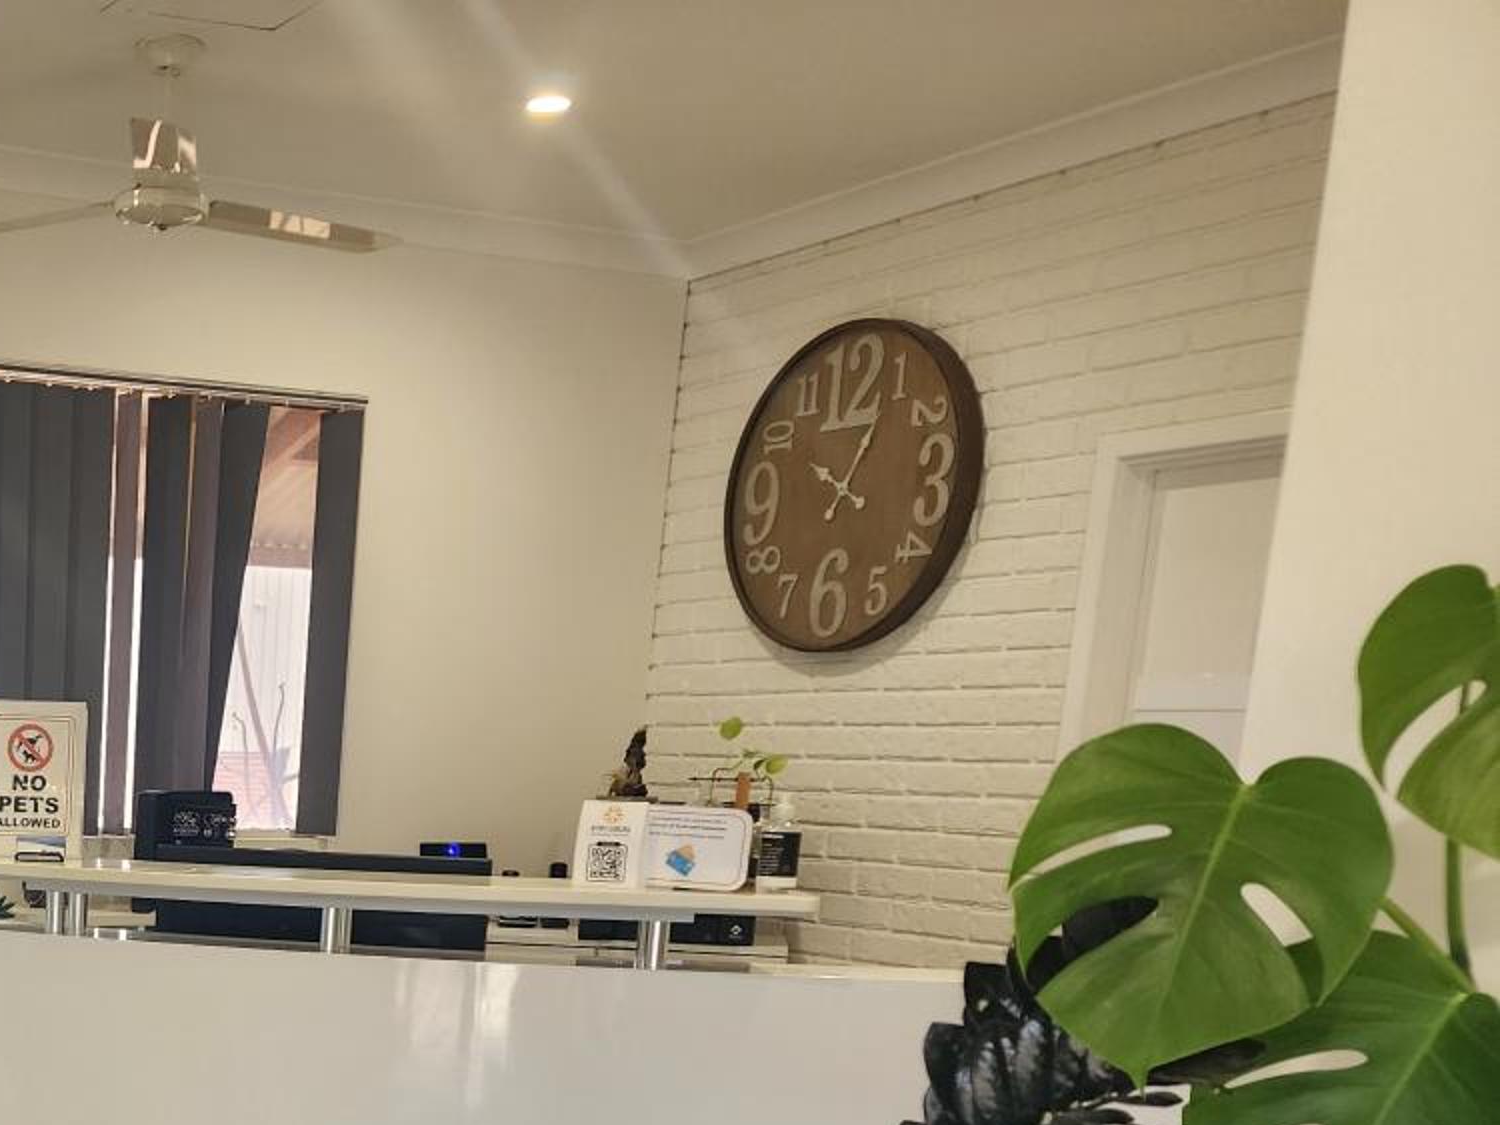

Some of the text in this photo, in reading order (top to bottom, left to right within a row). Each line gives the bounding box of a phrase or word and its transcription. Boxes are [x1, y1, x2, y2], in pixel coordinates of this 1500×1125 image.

[795, 374, 821, 417] 11
[820, 333, 885, 432] 12
[891, 351, 908, 401] 1
[911, 398, 948, 428] 2
[763, 419, 794, 455] 10
[913, 433, 955, 527] 3
[744, 461, 780, 546] 9
[746, 545, 781, 575] 8
[894, 530, 933, 563] 4
[777, 573, 800, 619] 7
[809, 548, 848, 638] 6
[864, 565, 888, 616] 5
[12, 774, 47, 791] NO
